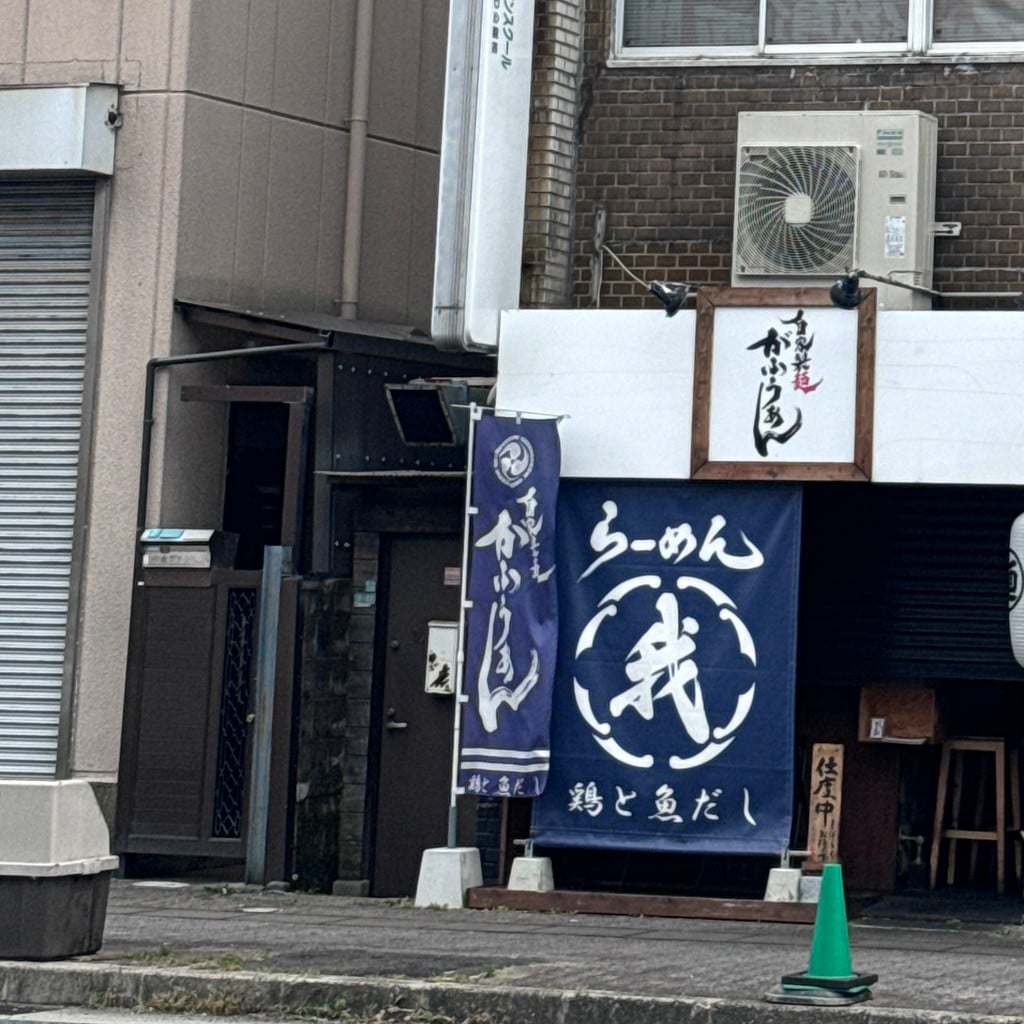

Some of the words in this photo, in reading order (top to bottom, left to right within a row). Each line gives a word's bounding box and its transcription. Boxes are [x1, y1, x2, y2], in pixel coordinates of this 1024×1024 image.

[577, 500, 765, 583] らーめん
[609, 592, 711, 745] 我
[567, 782, 758, 826] 鶏と魚だし
